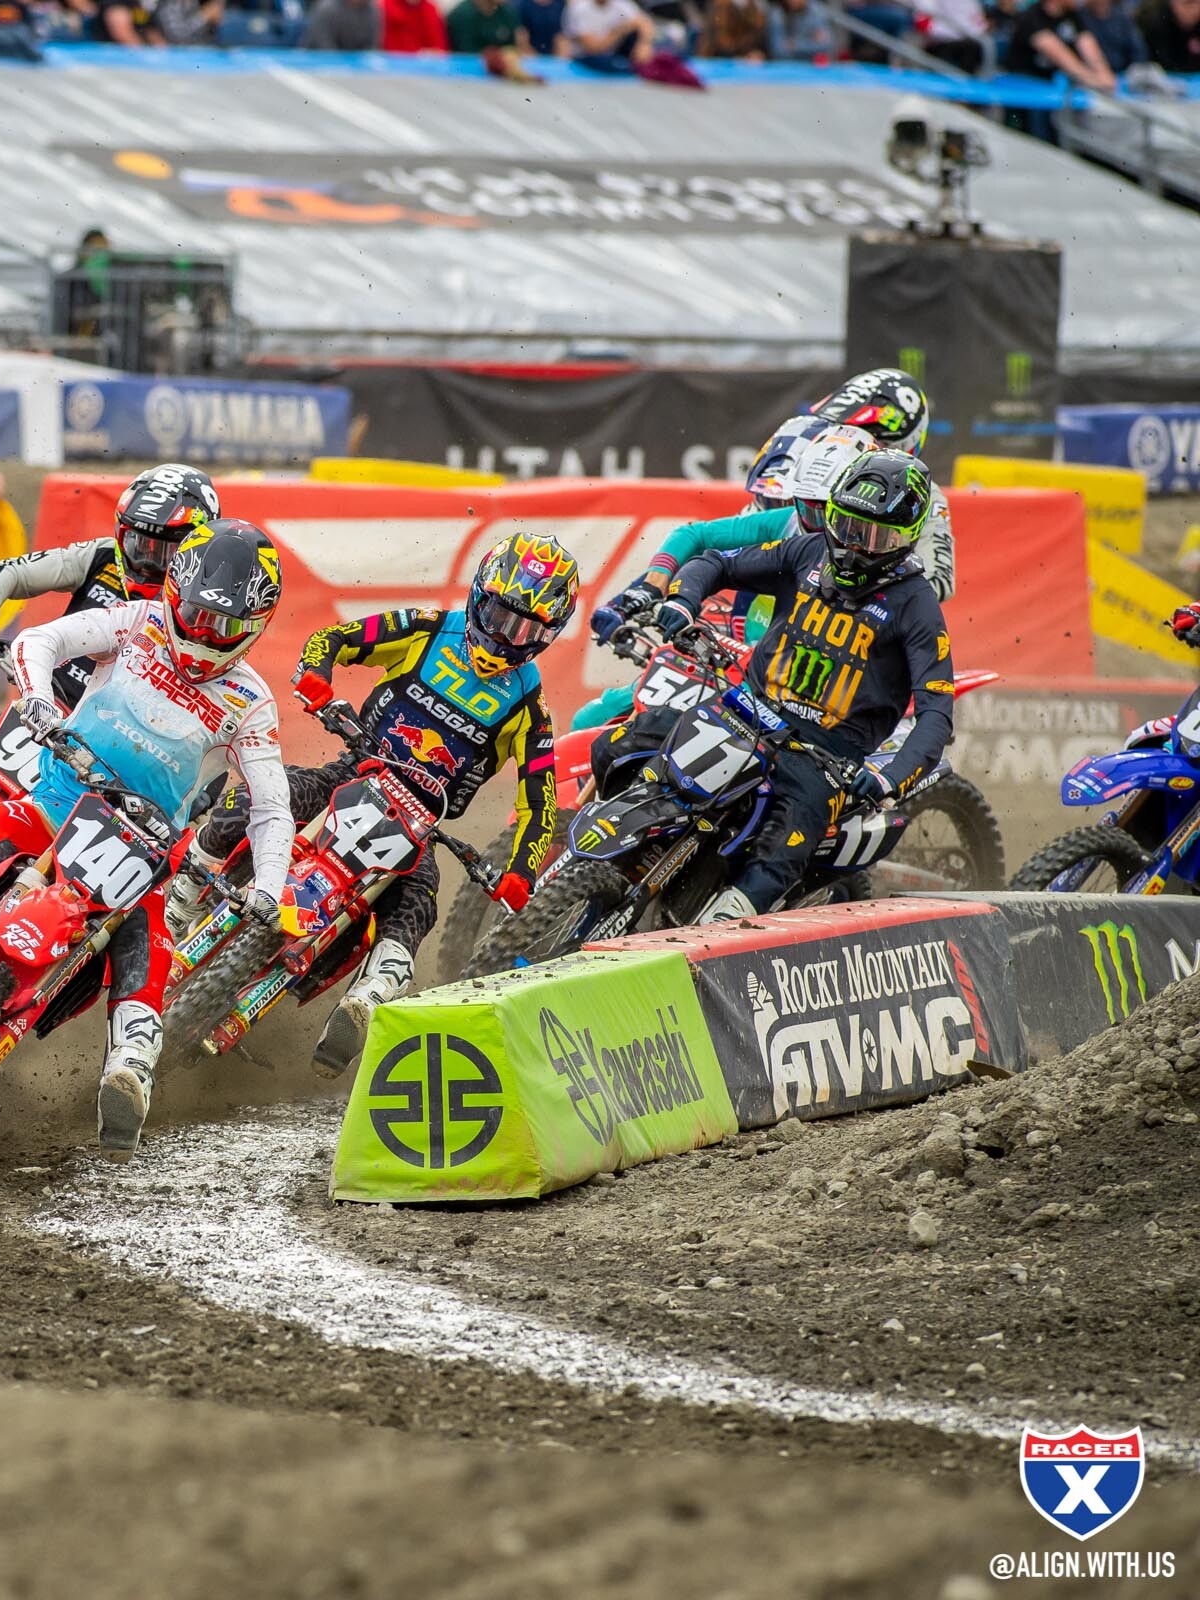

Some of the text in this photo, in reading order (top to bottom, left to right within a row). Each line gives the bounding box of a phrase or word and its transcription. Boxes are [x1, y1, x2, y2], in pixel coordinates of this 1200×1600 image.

[190, 394, 326, 449] YAMAHA
[789, 591, 876, 662] THOR
[139, 671, 222, 735] RACING
[149, 662, 229, 722] MOOSE
[214, 678, 244, 697] AMA
[405, 683, 490, 746] GASGAS
[430, 659, 501, 720] TLD
[637, 665, 717, 712] 54
[111, 719, 182, 774] HONDA
[726, 715, 757, 743] MONSTER
[387, 772, 432, 817] RENTHAL
[324, 802, 415, 870] 44
[832, 814, 887, 867] 11
[56, 816, 154, 912] 140
[325, 851, 353, 879] GASGAS
[0, 933, 36, 961] RED
[4, 922, 41, 951] RIDE
[20, 917, 45, 941] MOTUL
[186, 913, 227, 956] DUNLOP
[247, 974, 288, 1019] DUNLOP
[771, 939, 955, 1017] ROCKY MOUNTAIN
[575, 1004, 705, 1127] Kawasaki
